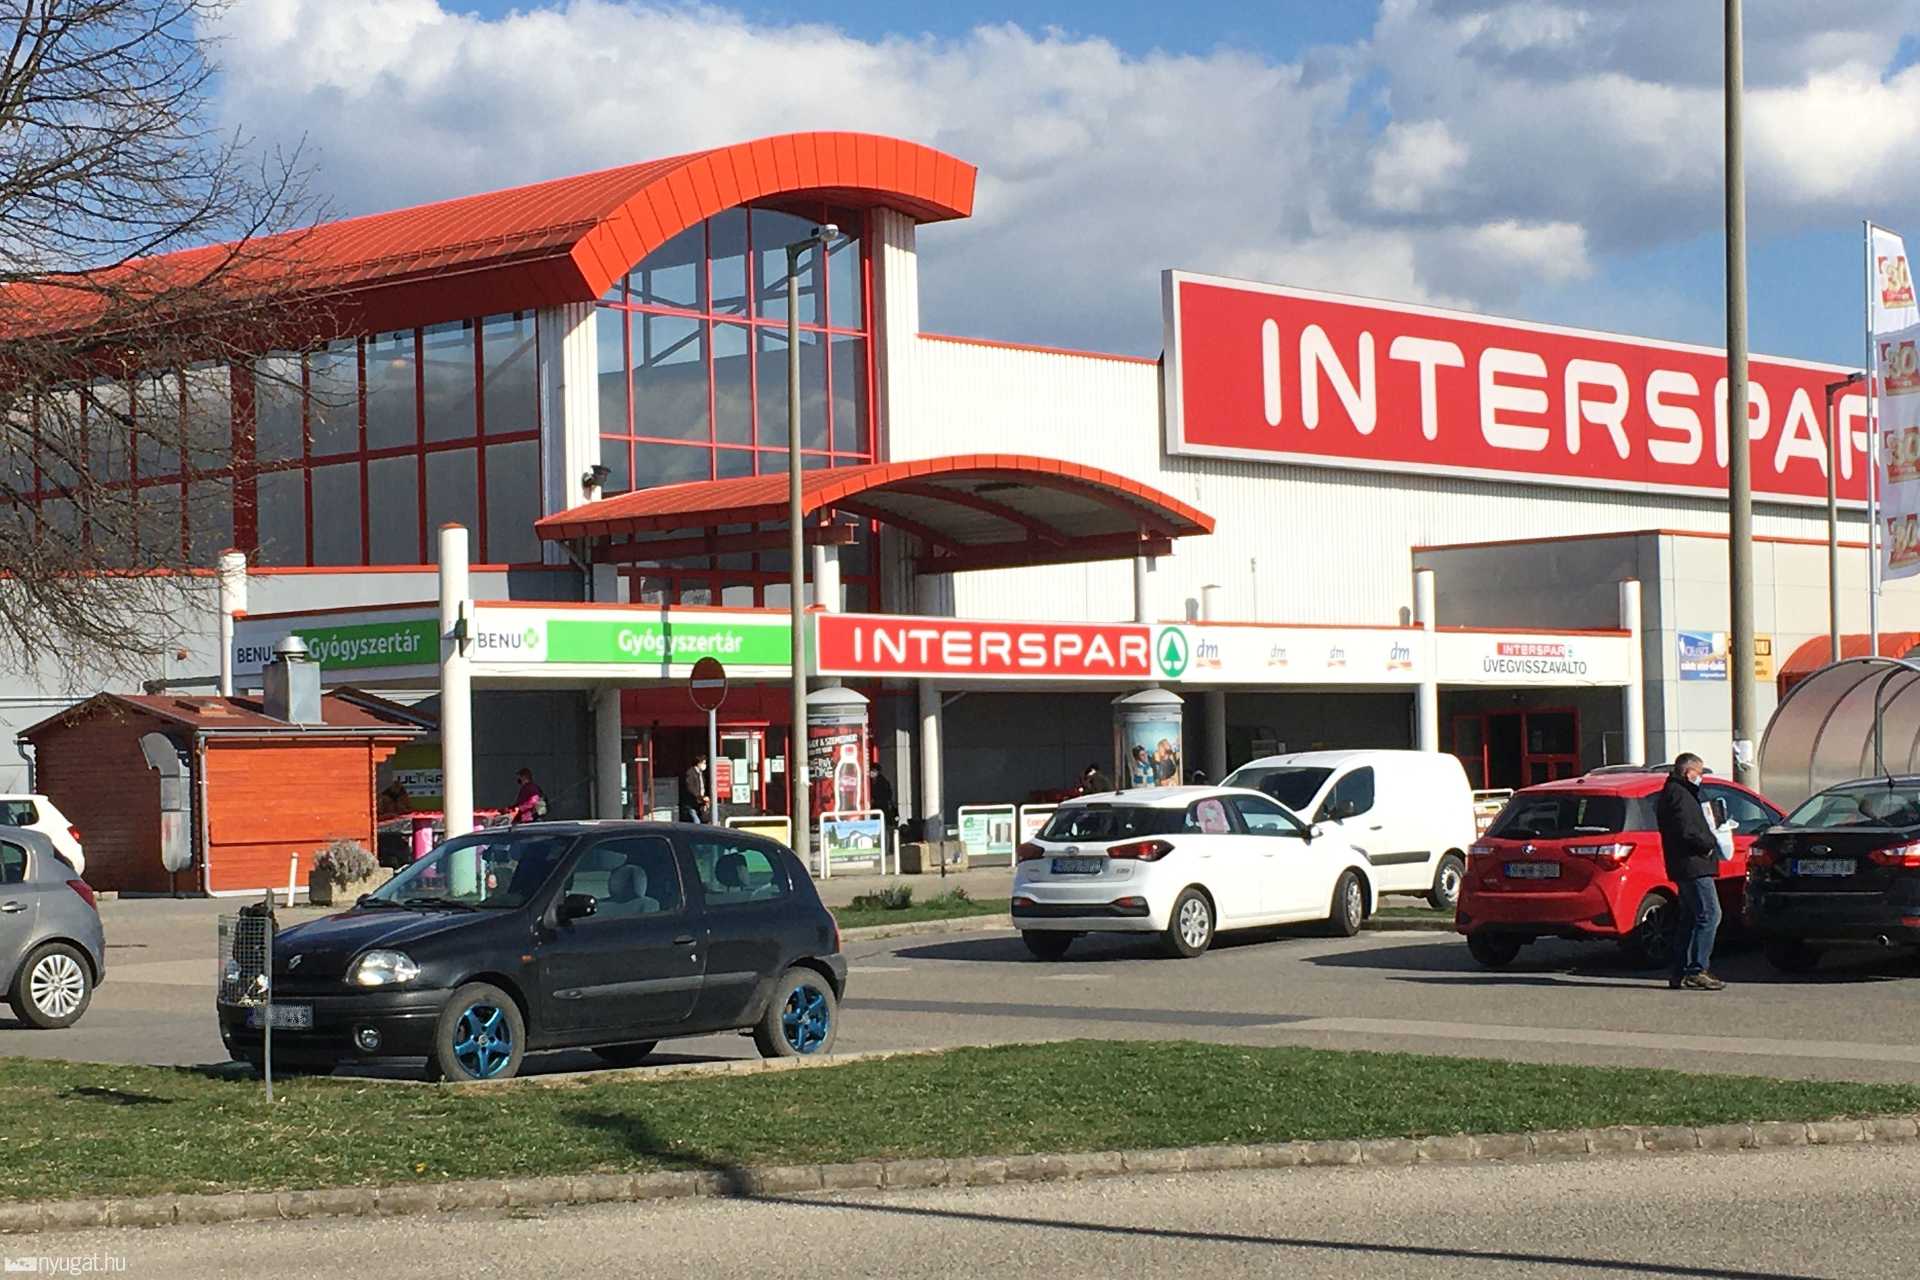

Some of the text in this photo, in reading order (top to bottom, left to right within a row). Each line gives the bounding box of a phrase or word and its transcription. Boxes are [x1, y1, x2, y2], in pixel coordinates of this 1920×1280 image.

[237, 629, 421, 664] BENU Gyógyszertár
[477, 629, 743, 655] BENU Gyógyszertár
[854, 626, 1148, 669] INTERSPAR
[1196, 639, 1219, 659] dm
[1390, 642, 1410, 660] dm
[1502, 643, 1564, 657] INTERSPAR
